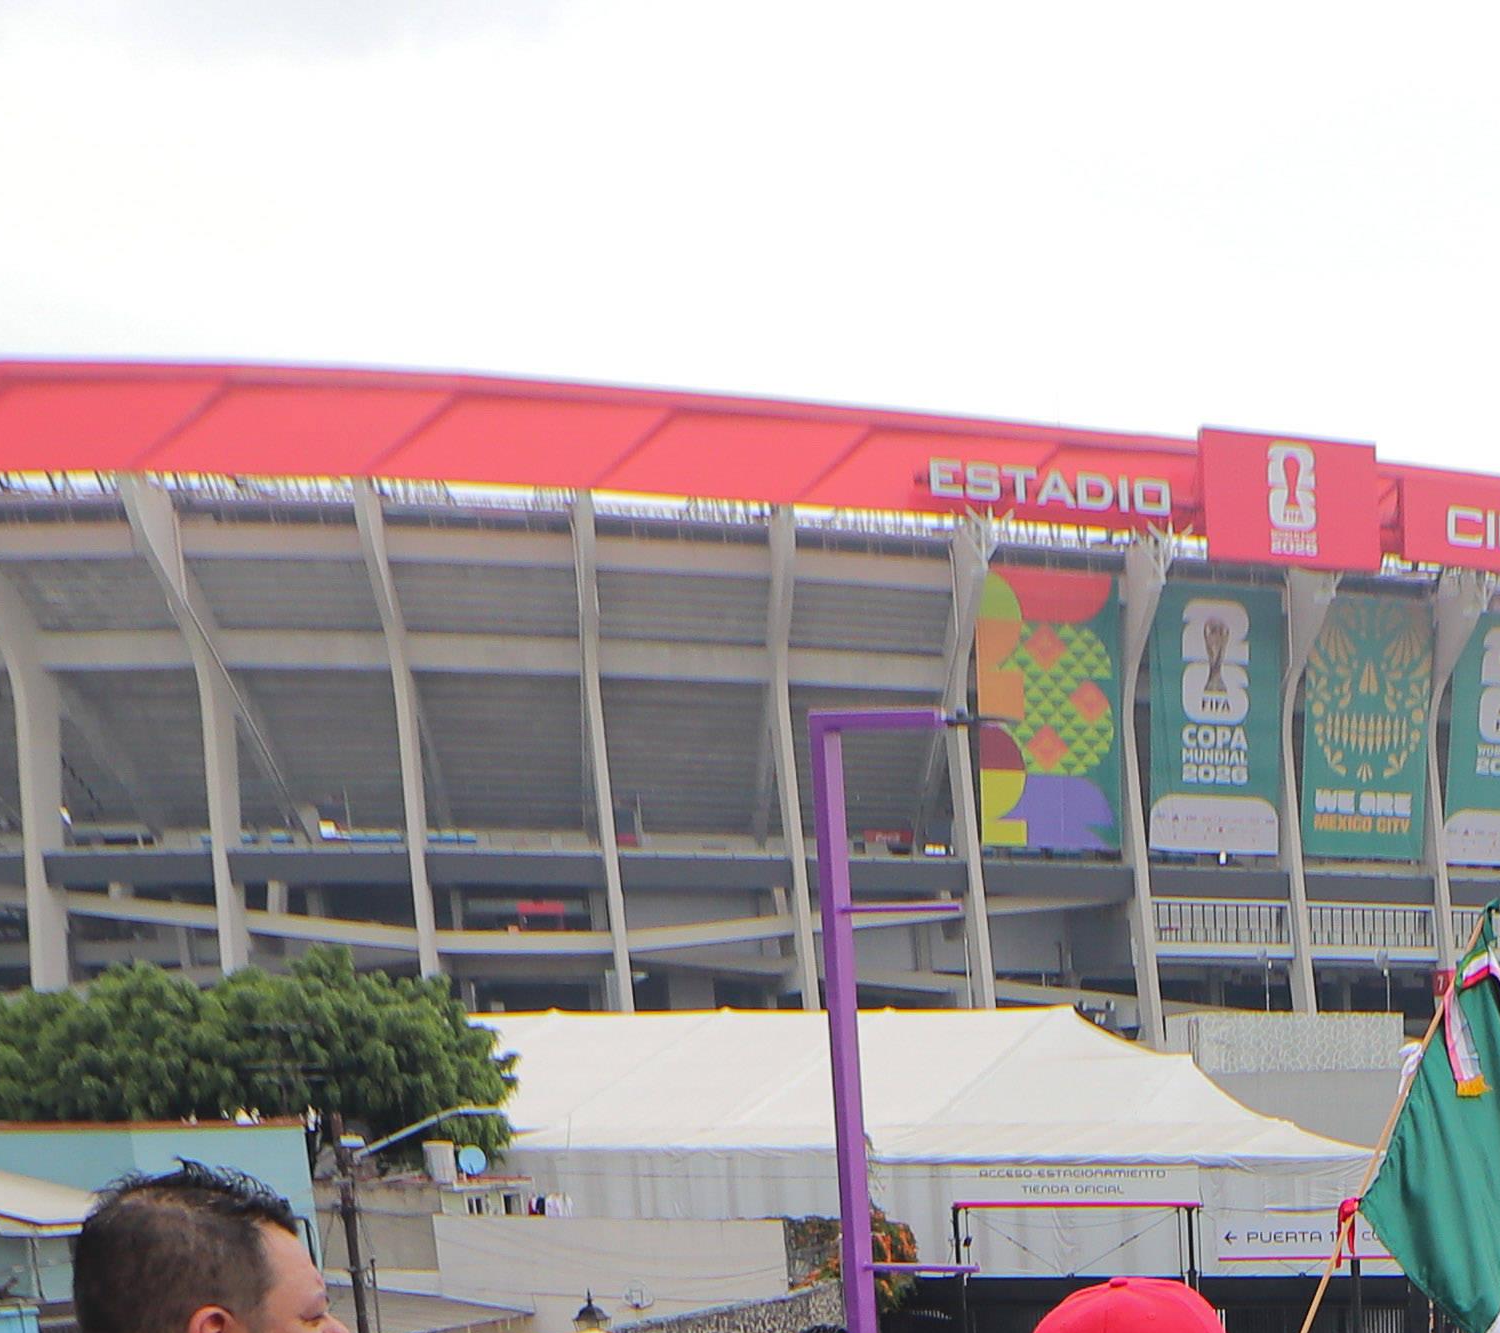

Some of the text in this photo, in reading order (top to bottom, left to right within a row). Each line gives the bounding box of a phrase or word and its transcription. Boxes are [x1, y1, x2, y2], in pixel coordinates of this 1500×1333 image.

[928, 455, 1173, 518] ESTADIO
[1202, 697, 1231, 714] FIFA
[1181, 724, 1249, 750] COPA
[1182, 748, 1249, 766] MUNDIAL
[1182, 762, 1249, 786] 2026
[1315, 788, 1412, 818] WE ARE
[1376, 815, 1412, 835] CITY
[978, 1168, 1167, 1179] ACCESO ESTACIONAMIENTO
[1021, 1184, 1125, 1196] TIENDA OFICIAL
[1246, 1231, 1323, 1244] PUERTA
